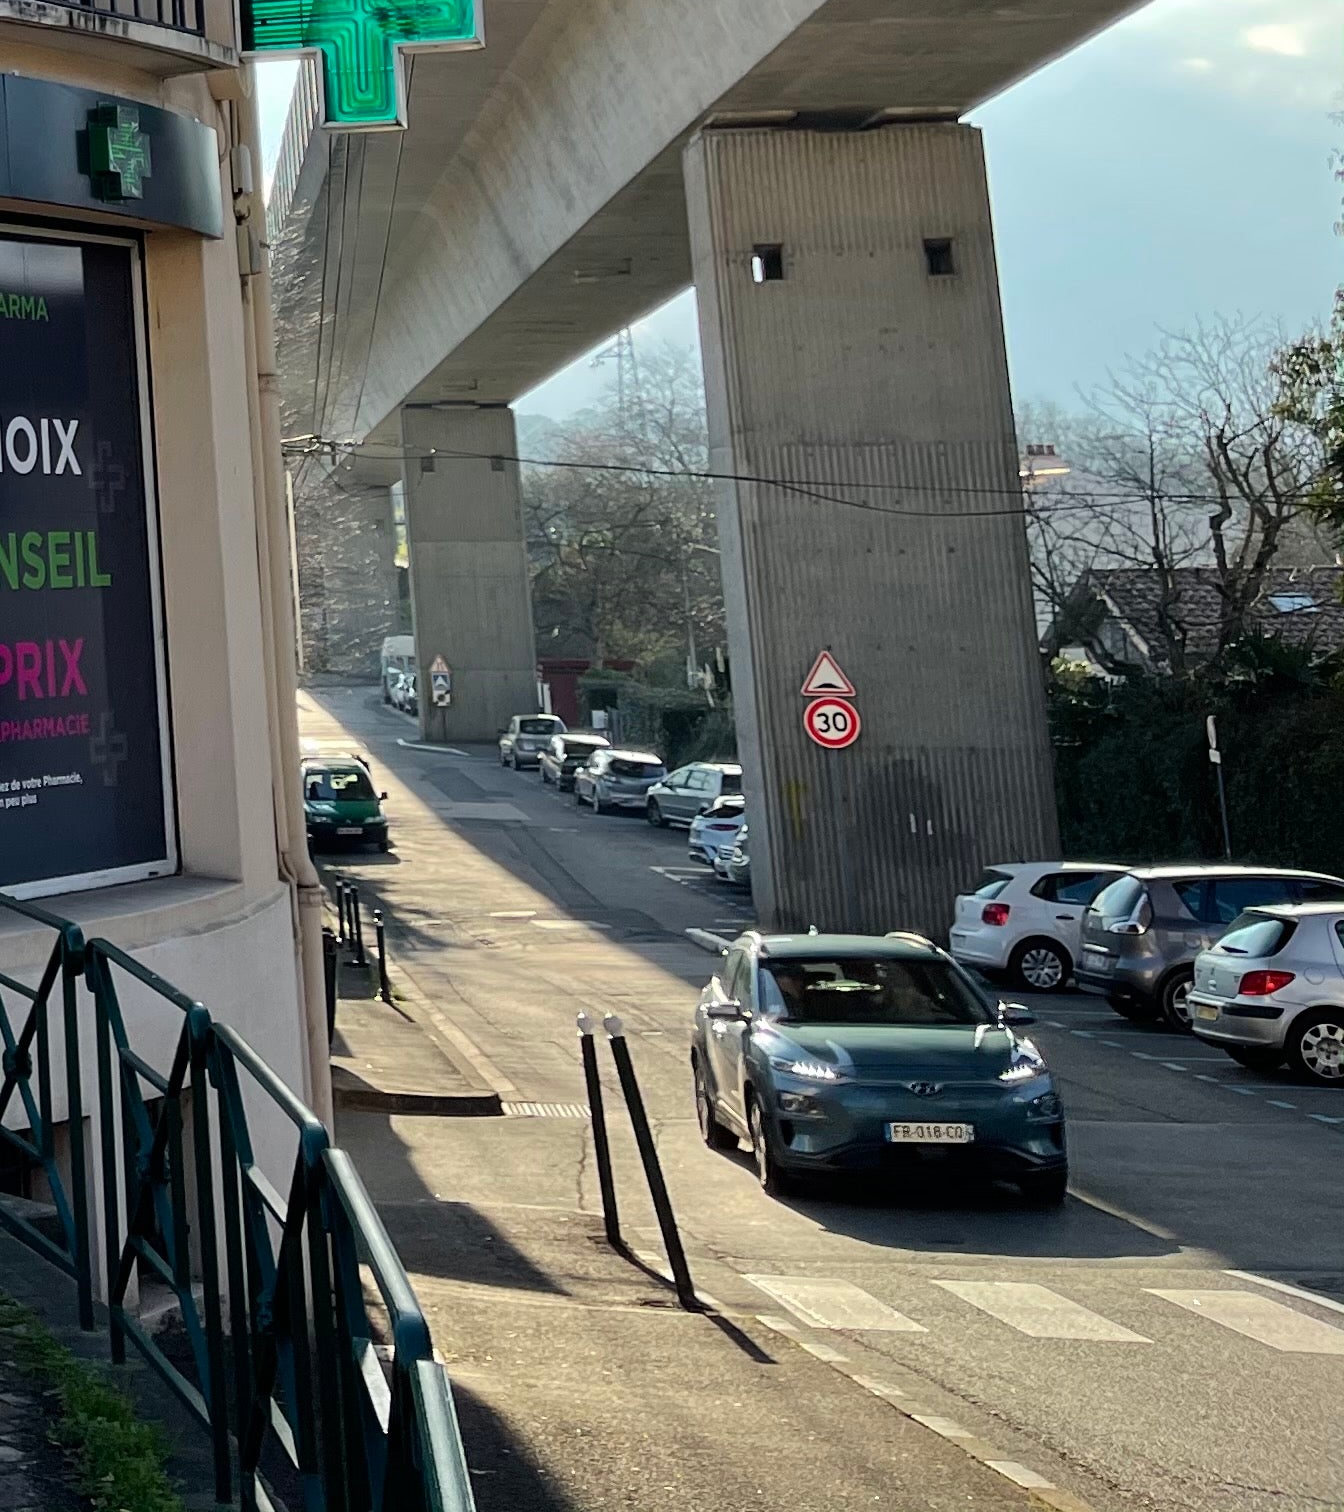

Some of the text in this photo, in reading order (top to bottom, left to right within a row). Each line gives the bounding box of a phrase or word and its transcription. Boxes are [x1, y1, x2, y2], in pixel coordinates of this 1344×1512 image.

[816, 712, 848, 733] 30
[11, 779, 21, 791] de
[22, 777, 42, 789] votre
[5, 796, 20, 809] peu
[21, 793, 38, 808] plus
